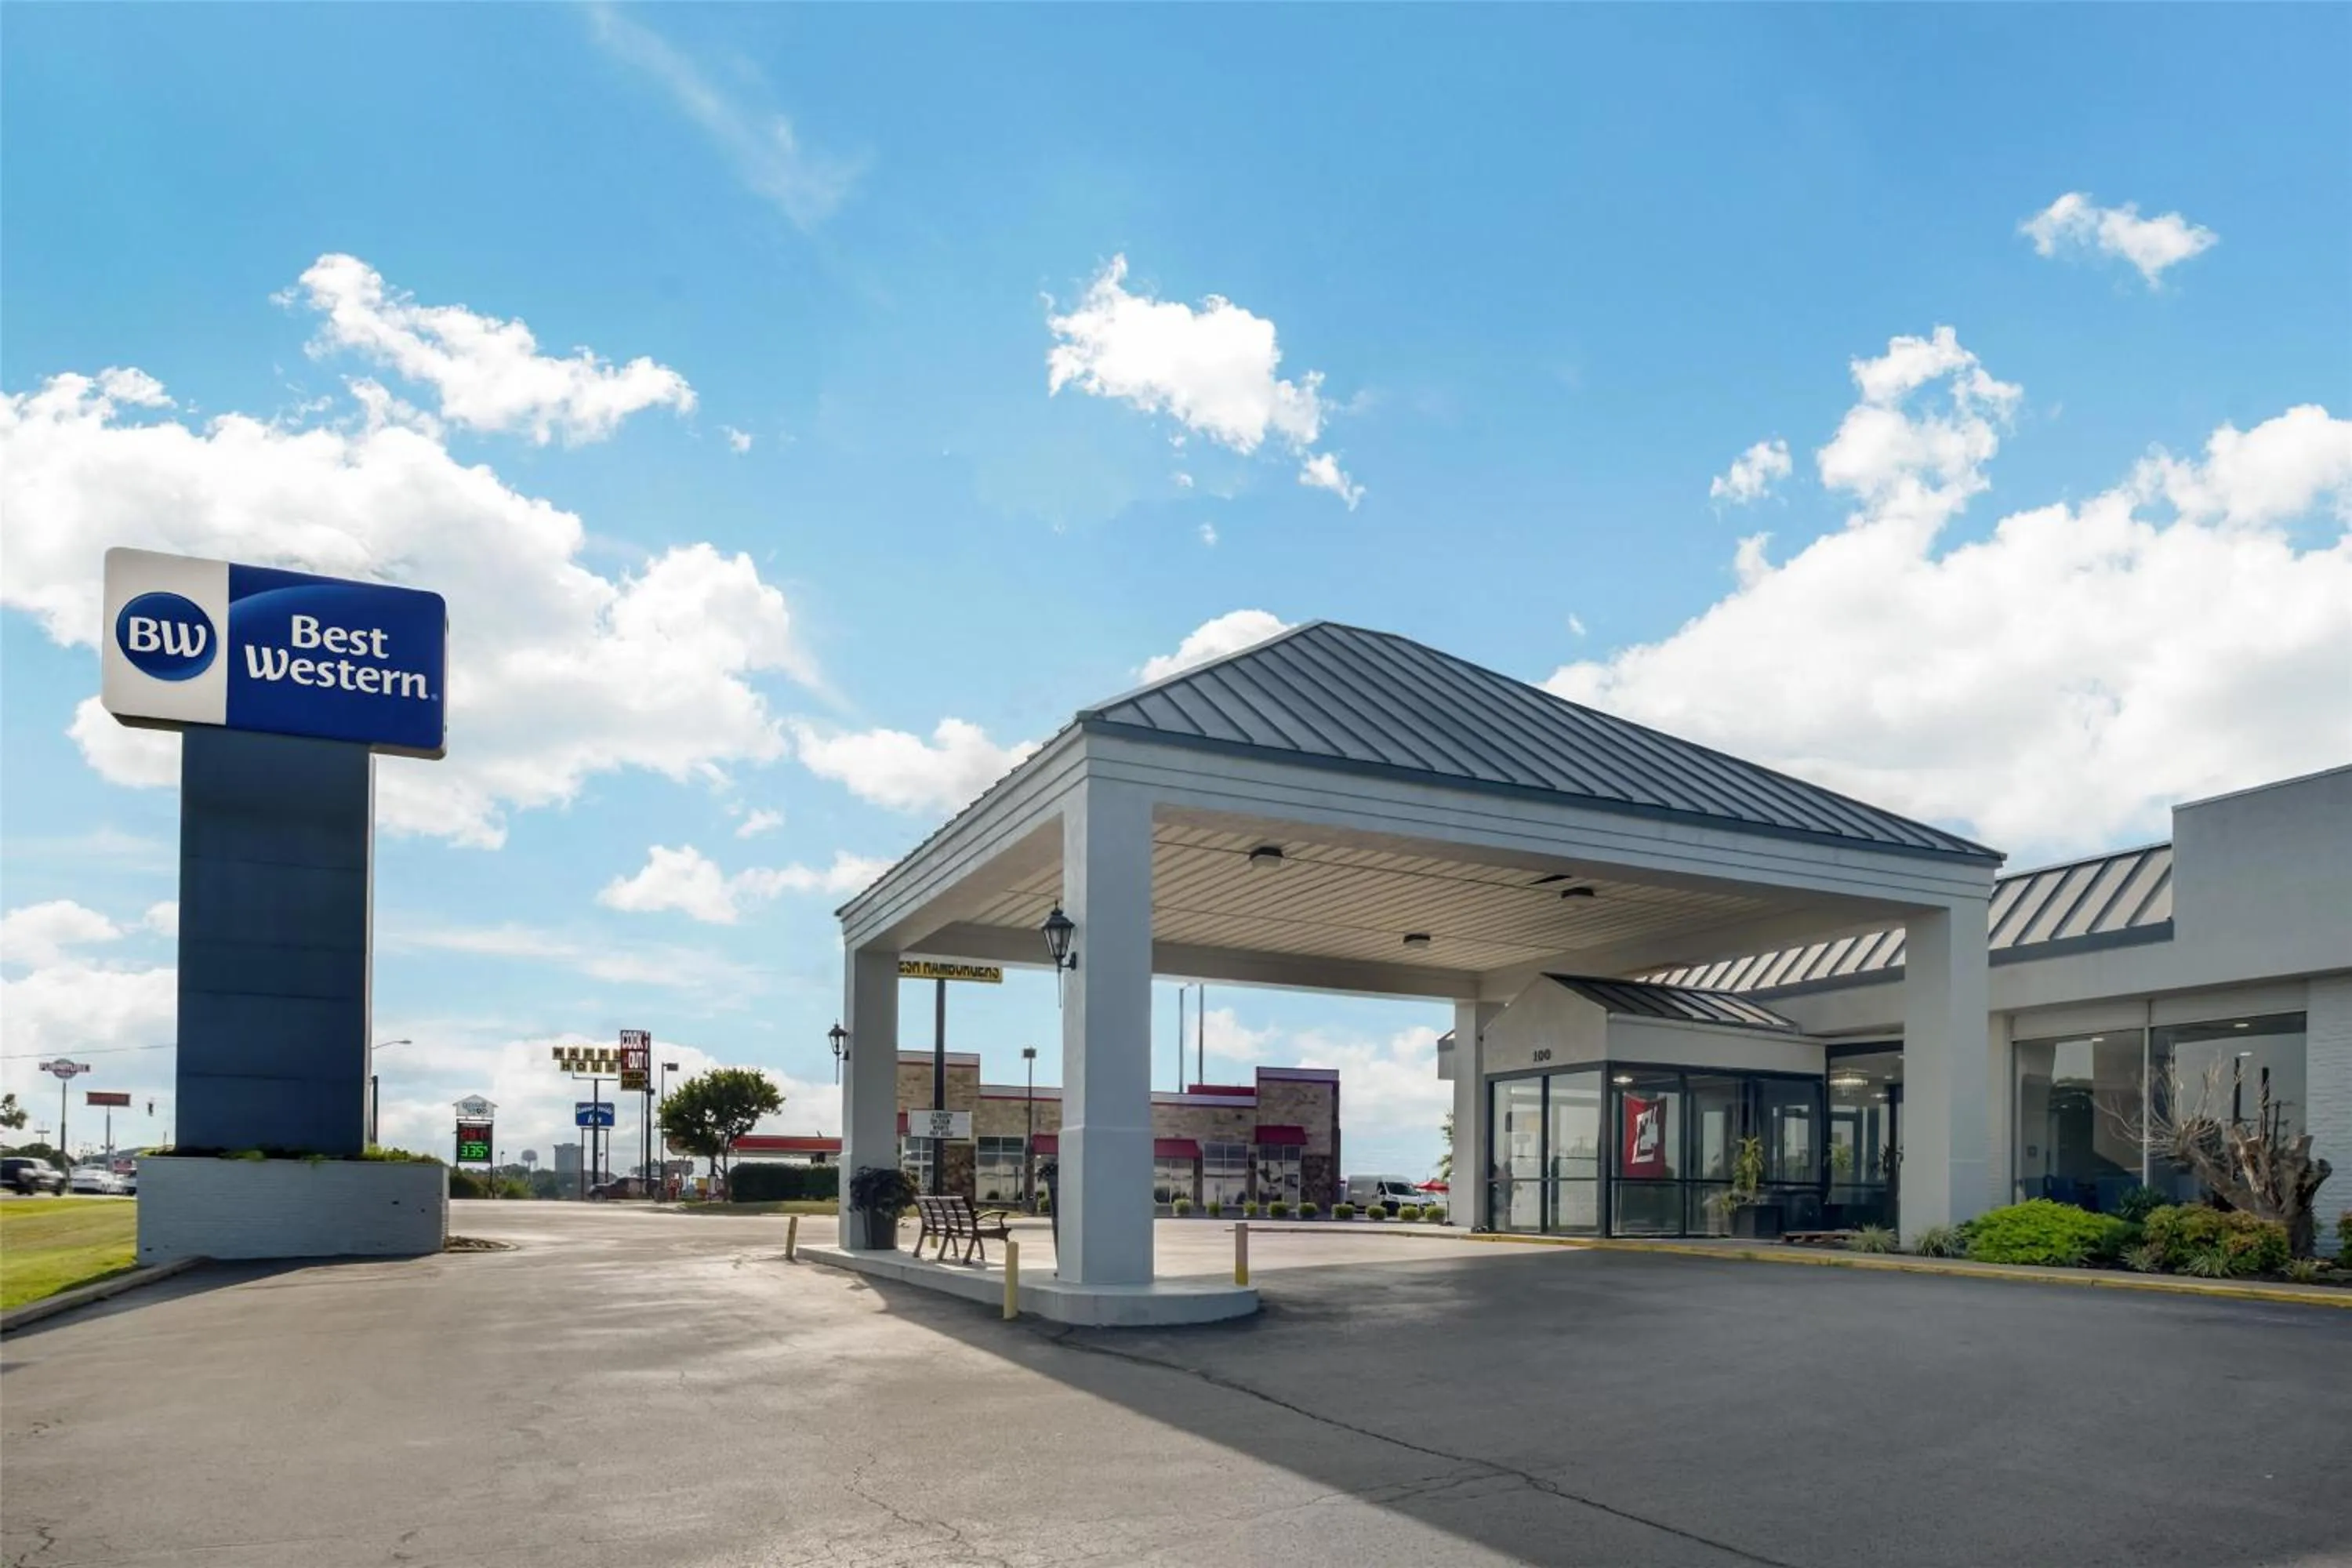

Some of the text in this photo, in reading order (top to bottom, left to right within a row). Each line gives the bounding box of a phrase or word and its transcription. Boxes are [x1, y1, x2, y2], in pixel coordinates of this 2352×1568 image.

[128, 616, 207, 658] BW
[290, 614, 390, 659] Best
[244, 644, 429, 700] Western
[560, 1060, 618, 1073] HOUS
[628, 1051, 644, 1069] OUT
[1533, 1049, 1552, 1062] 100
